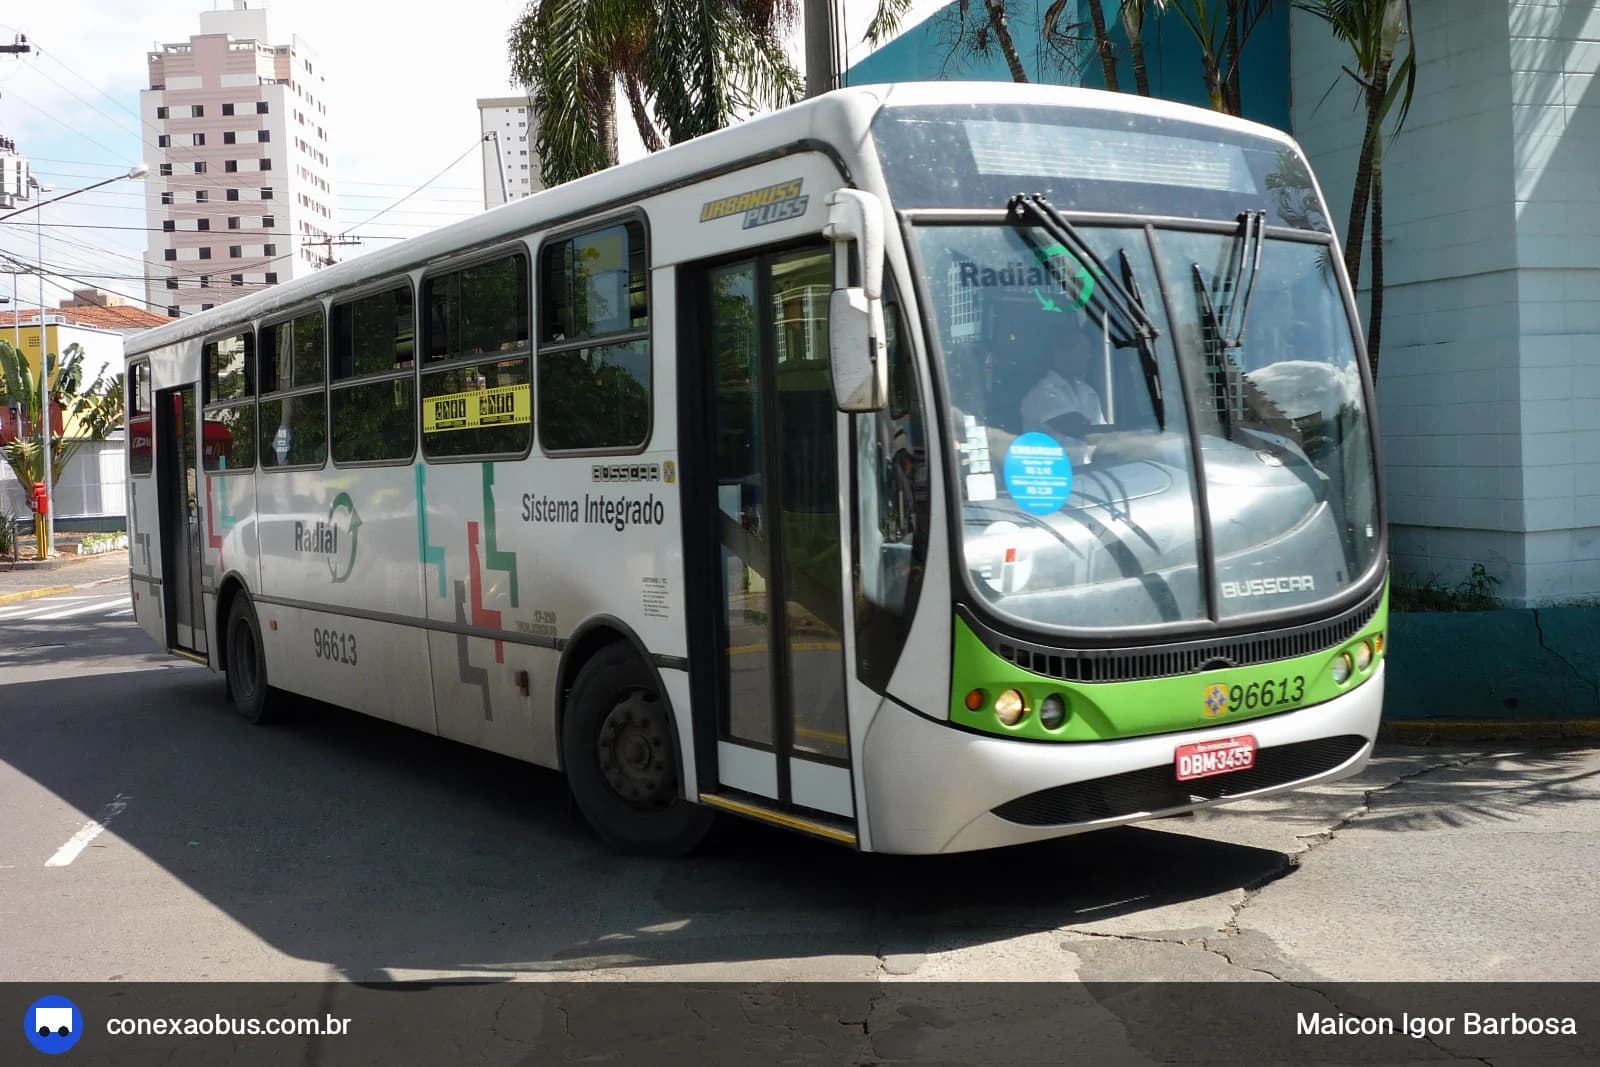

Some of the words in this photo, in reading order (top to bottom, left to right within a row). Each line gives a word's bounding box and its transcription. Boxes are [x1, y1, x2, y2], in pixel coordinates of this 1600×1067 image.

[700, 178, 803, 222] URBANUSS
[743, 195, 808, 229] PLUSS
[960, 261, 1051, 287] Radial
[522, 493, 579, 522] Sistema
[585, 493, 664, 532] Integrado
[295, 521, 338, 554] Radial
[1221, 575, 1315, 598] BUSSCAR
[314, 627, 357, 666] 96613
[1228, 675, 1305, 712] 96613
